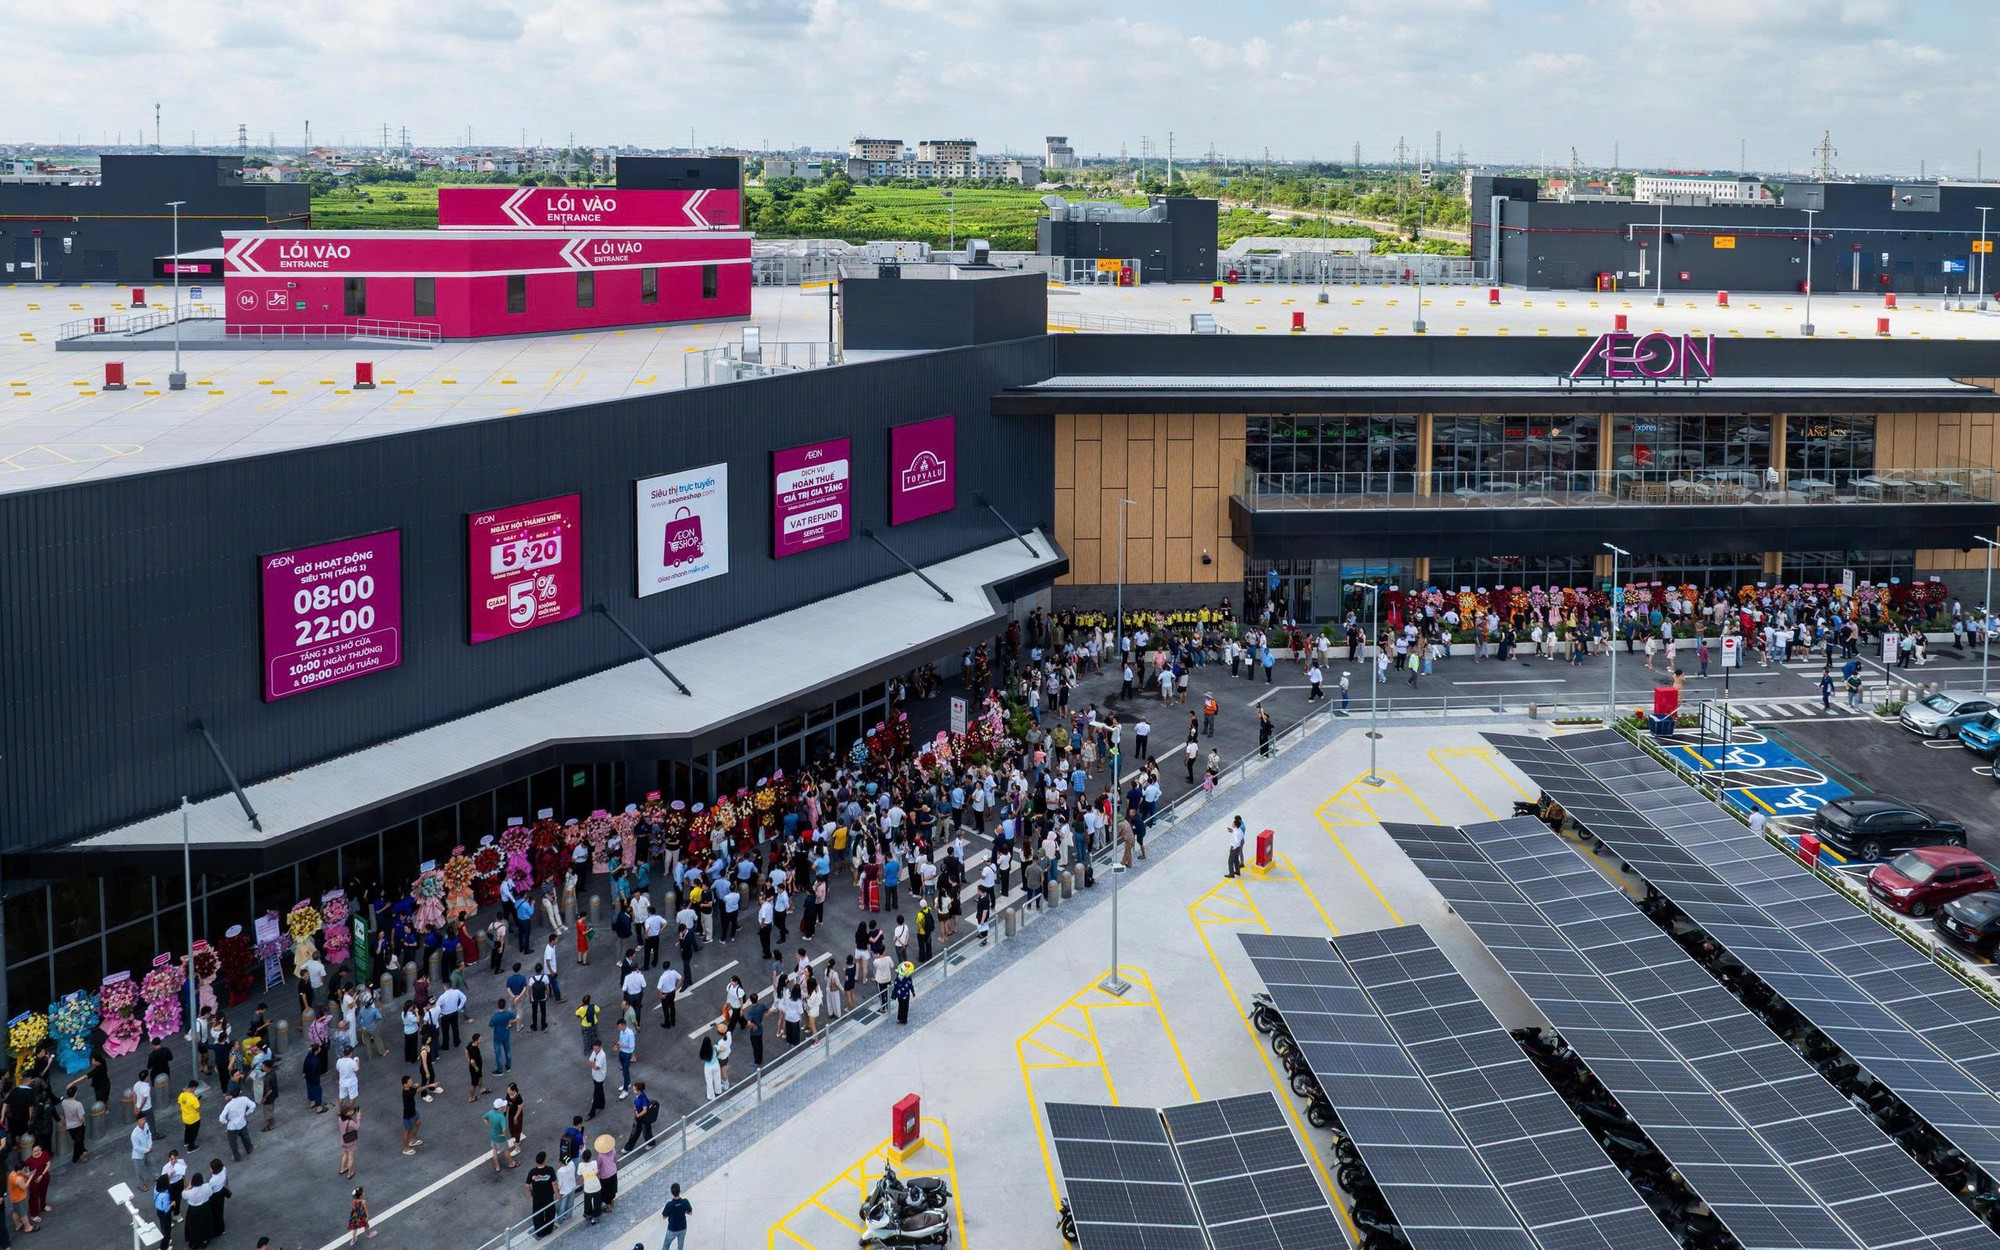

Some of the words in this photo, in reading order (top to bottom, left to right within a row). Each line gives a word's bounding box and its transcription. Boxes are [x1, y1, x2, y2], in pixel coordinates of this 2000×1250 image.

[547, 194, 575, 211] LỐI
[582, 195, 617, 212] VÀO
[547, 213, 601, 222] ENTRANCE
[280, 241, 308, 259] LỐI
[313, 242, 350, 259] VÀO
[594, 240, 615, 255] LỐI
[617, 241, 642, 254] VÀO
[280, 260, 329, 268] ENTRANCE
[594, 255, 629, 263] ENTRANCE
[241, 295, 254, 305] 04
[792, 478, 814, 490] HOÀN
[816, 470, 836, 485] THUẾ
[906, 468, 942, 484] TOPVALU
[783, 492, 797, 503] GIÁ
[798, 490, 809, 500] TRỊ
[810, 486, 823, 496] GIA
[790, 517, 807, 529] VAT
[807, 510, 838, 524] REFUND
[803, 527, 824, 537] SERVICE
[502, 544, 516, 567] 5
[522, 546, 530, 558] &
[531, 540, 557, 564] 20
[294, 562, 312, 575] GIỜ
[315, 557, 343, 571] HOẠT
[344, 551, 373, 565] ĐỘNG
[301, 573, 318, 584] SIÊU
[320, 571, 333, 580] THỊ
[294, 575, 374, 614] 08:00
[295, 605, 375, 646] 22:00
[289, 659, 320, 675] 10:00
[323, 654, 347, 668] (NGÀY
[301, 669, 332, 685] 09:00
